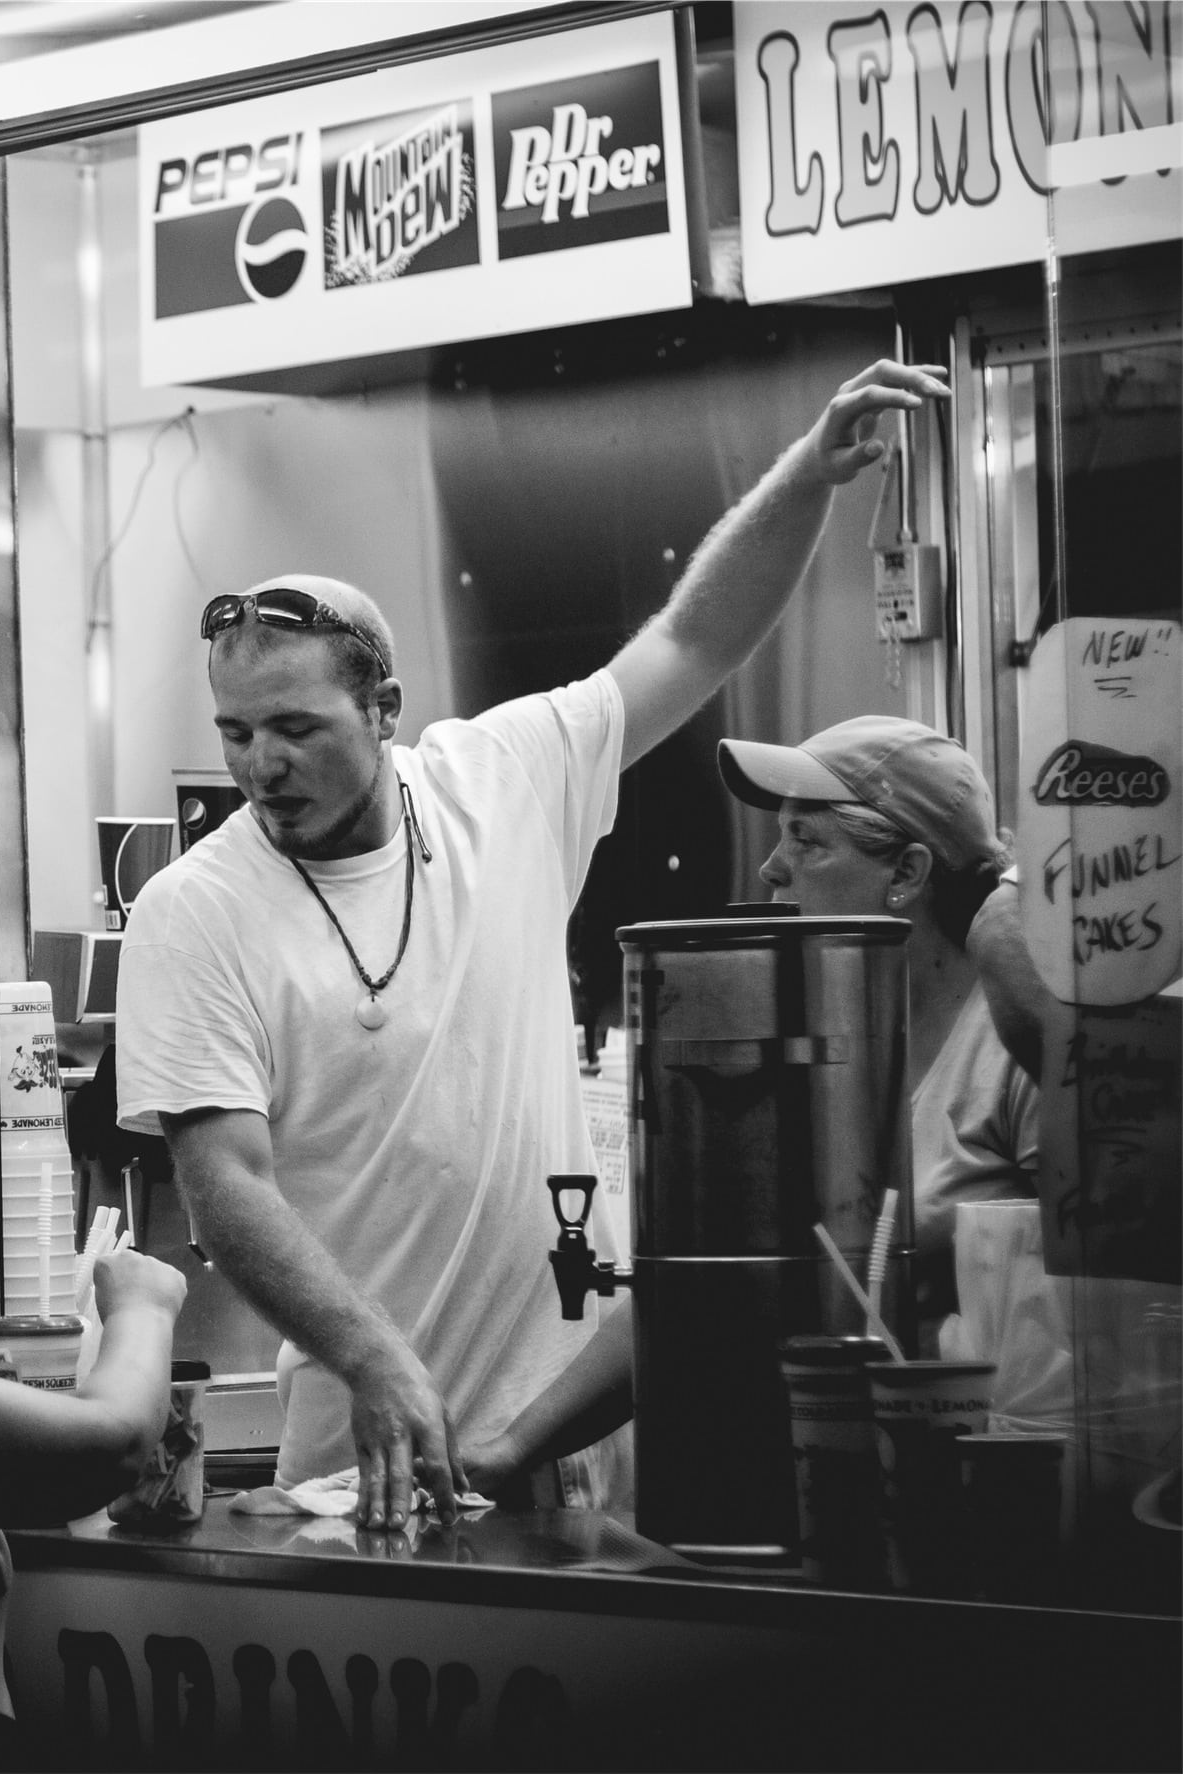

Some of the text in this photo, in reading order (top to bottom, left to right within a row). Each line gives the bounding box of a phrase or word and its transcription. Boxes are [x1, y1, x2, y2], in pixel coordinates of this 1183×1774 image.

[551, 102, 614, 163] Dr
[154, 131, 306, 213] PEPSI
[501, 124, 662, 224] Pepper
[1042, 833, 1183, 905] FUNNEL
[1071, 901, 1165, 966] CAKES
[11, 1117, 54, 1129] LEMONADE
